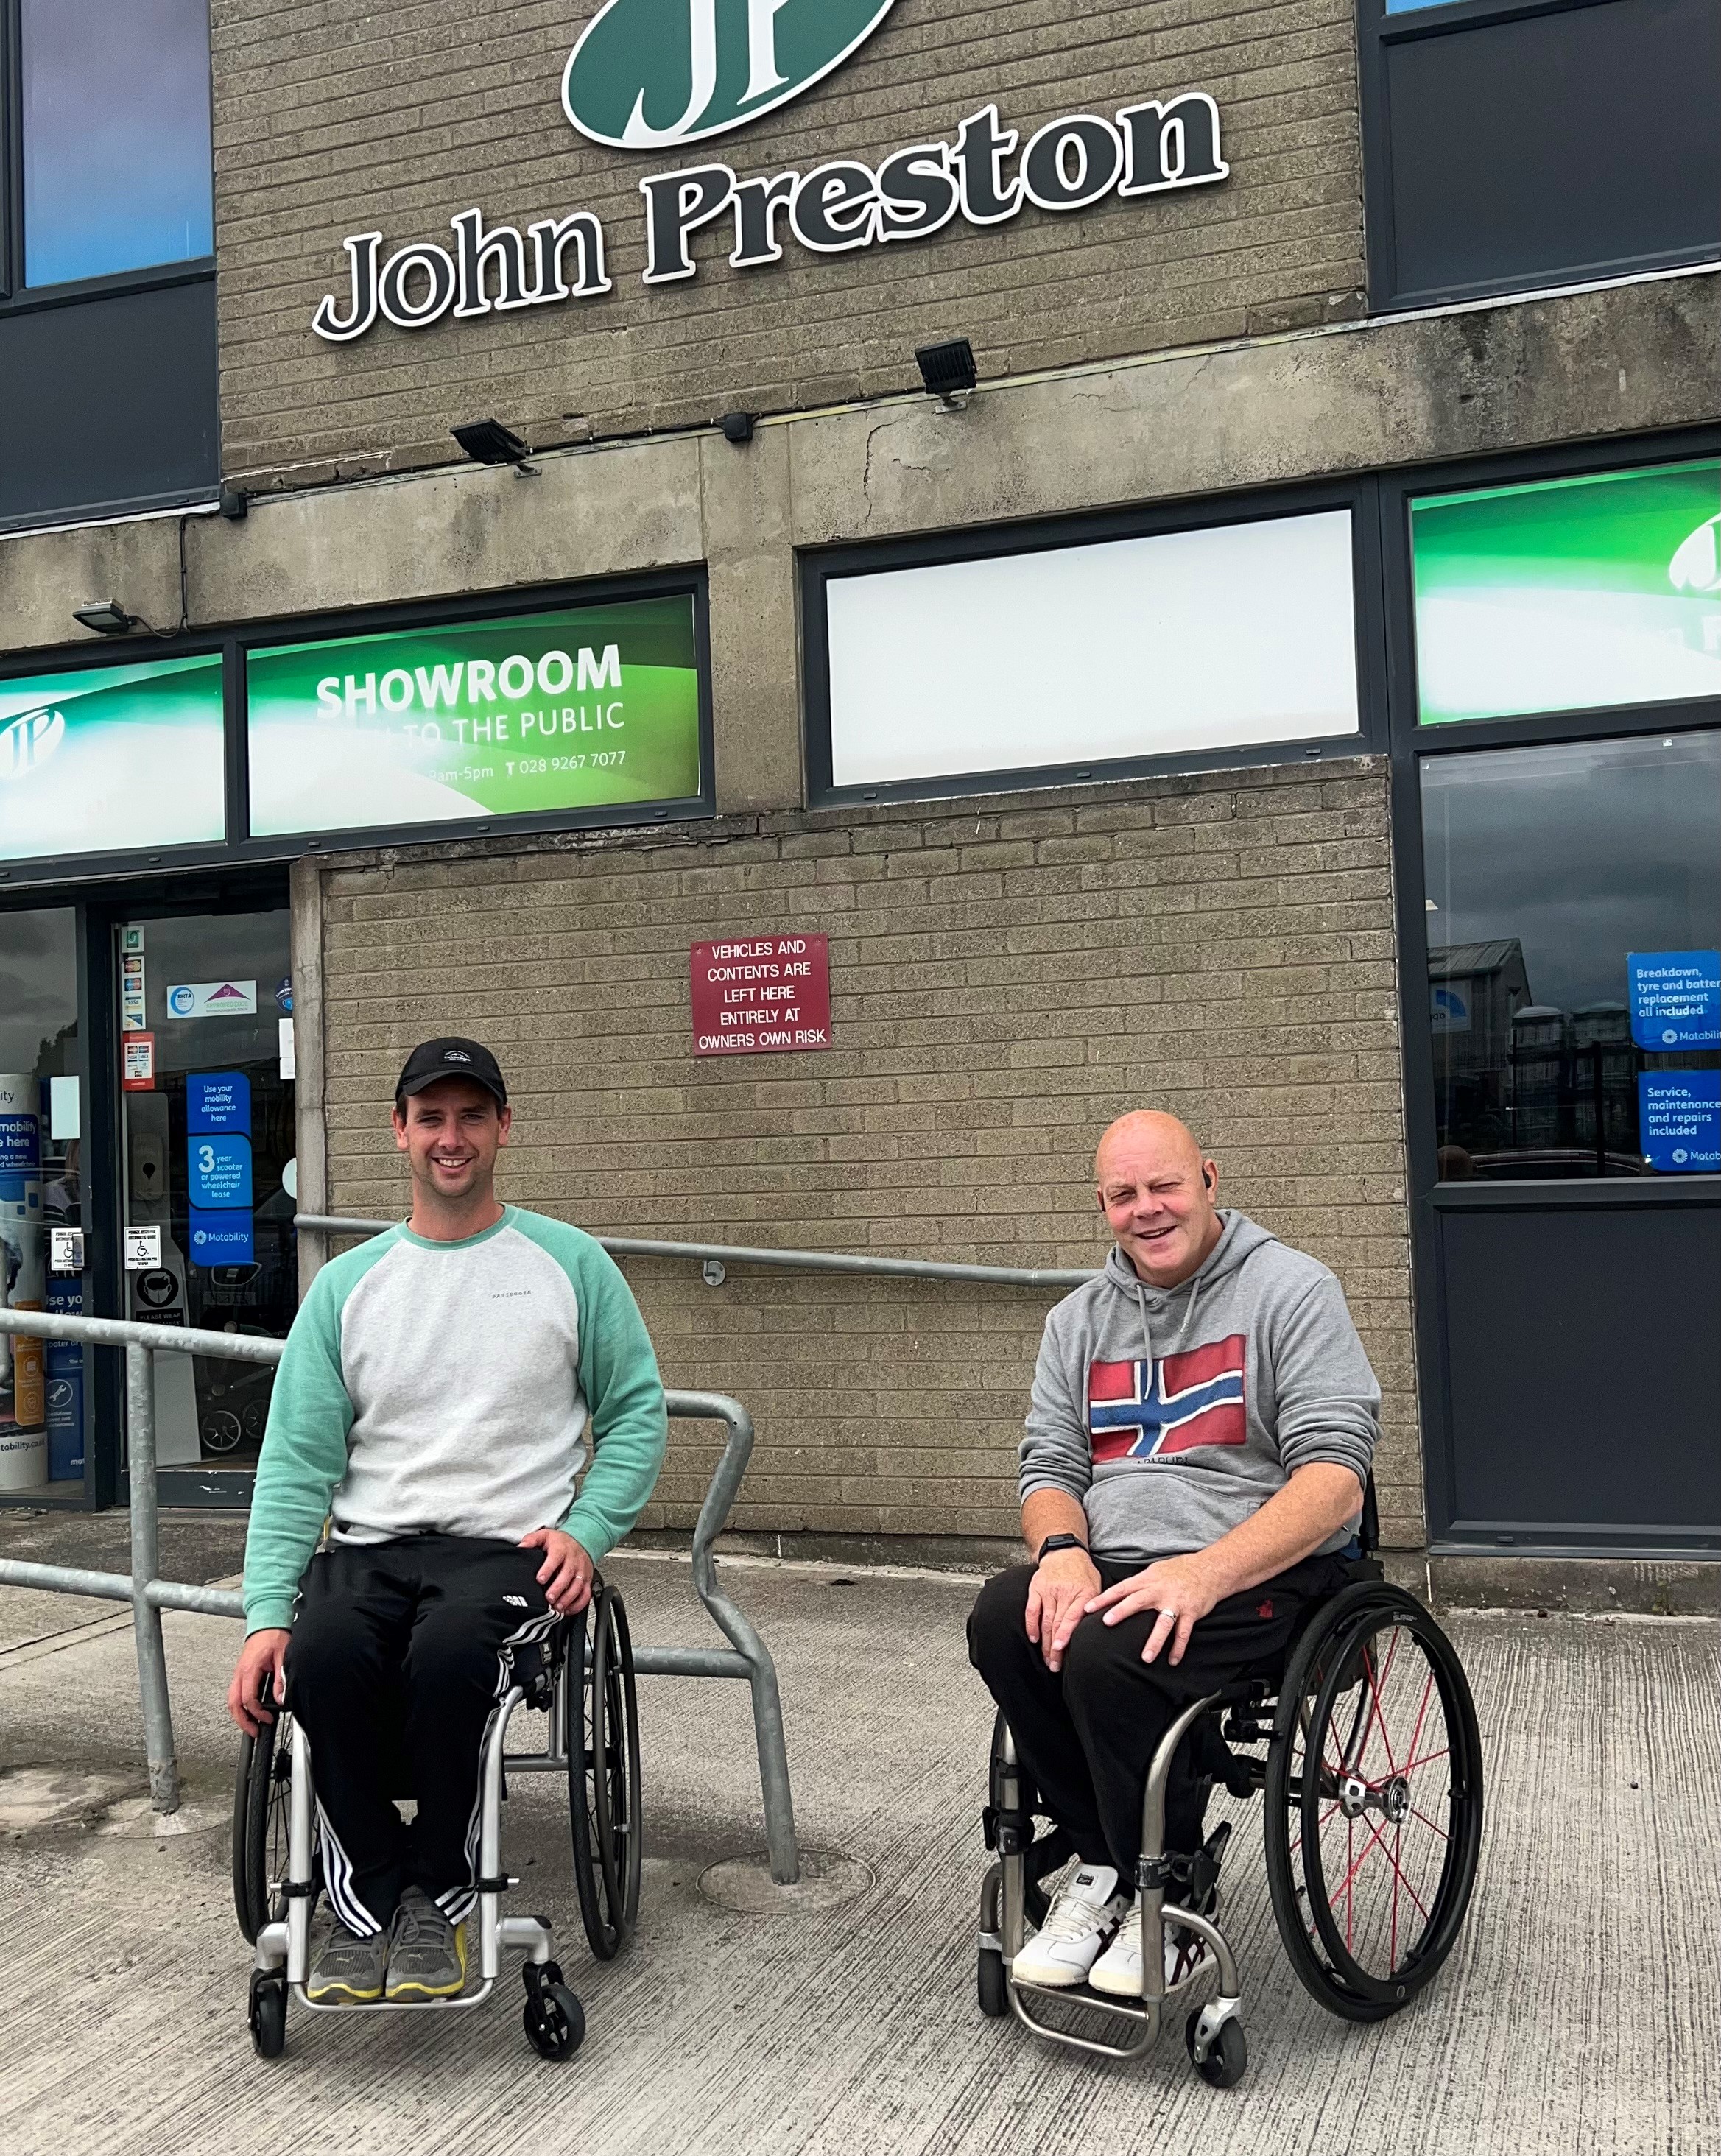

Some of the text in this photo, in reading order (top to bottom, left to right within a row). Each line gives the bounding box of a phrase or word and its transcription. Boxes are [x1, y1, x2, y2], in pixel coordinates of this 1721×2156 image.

[312, 92, 1228, 341] John Preston
[317, 644, 622, 719] SHOWROOM
[402, 722, 442, 749] TO
[452, 714, 510, 744] THE
[521, 702, 624, 737] PUBLIC
[506, 761, 515, 775] T
[519, 759, 547, 775] 028
[551, 755, 586, 771] 9267
[591, 750, 627, 767] 7077
[711, 940, 806, 959] VEHICLES AND
[707, 962, 811, 982] CONTENTS ARE
[1636, 967, 1702, 979] Breakdown,
[1637, 982, 1660, 993] tyre
[1662, 980, 1683, 990] and
[724, 985, 795, 1003] LEFT HERE
[1638, 993, 1709, 1006] replacement
[720, 1007, 800, 1026] ENTIRELY AT
[1639, 1005, 1704, 1017] all included
[699, 1029, 827, 1049] OWNERS OWN RISK
[217, 1085, 233, 1094] your
[1647, 1086, 1691, 1098] Service,
[205, 1093, 232, 1103] mobility
[201, 1105, 236, 1113] allowance
[1648, 1099, 1721, 1110] maintenance
[1648, 1112, 1712, 1124] and repairs
[1649, 1125, 1697, 1135] included
[7, 1136, 30, 1147] here
[198, 1145, 215, 1173] 3
[216, 1155, 232, 1163] year
[210, 1172, 241, 1182] powered
[201, 1180, 241, 1189] wheelchair
[211, 1190, 230, 1198] lease
[208, 1232, 249, 1243] Motability
